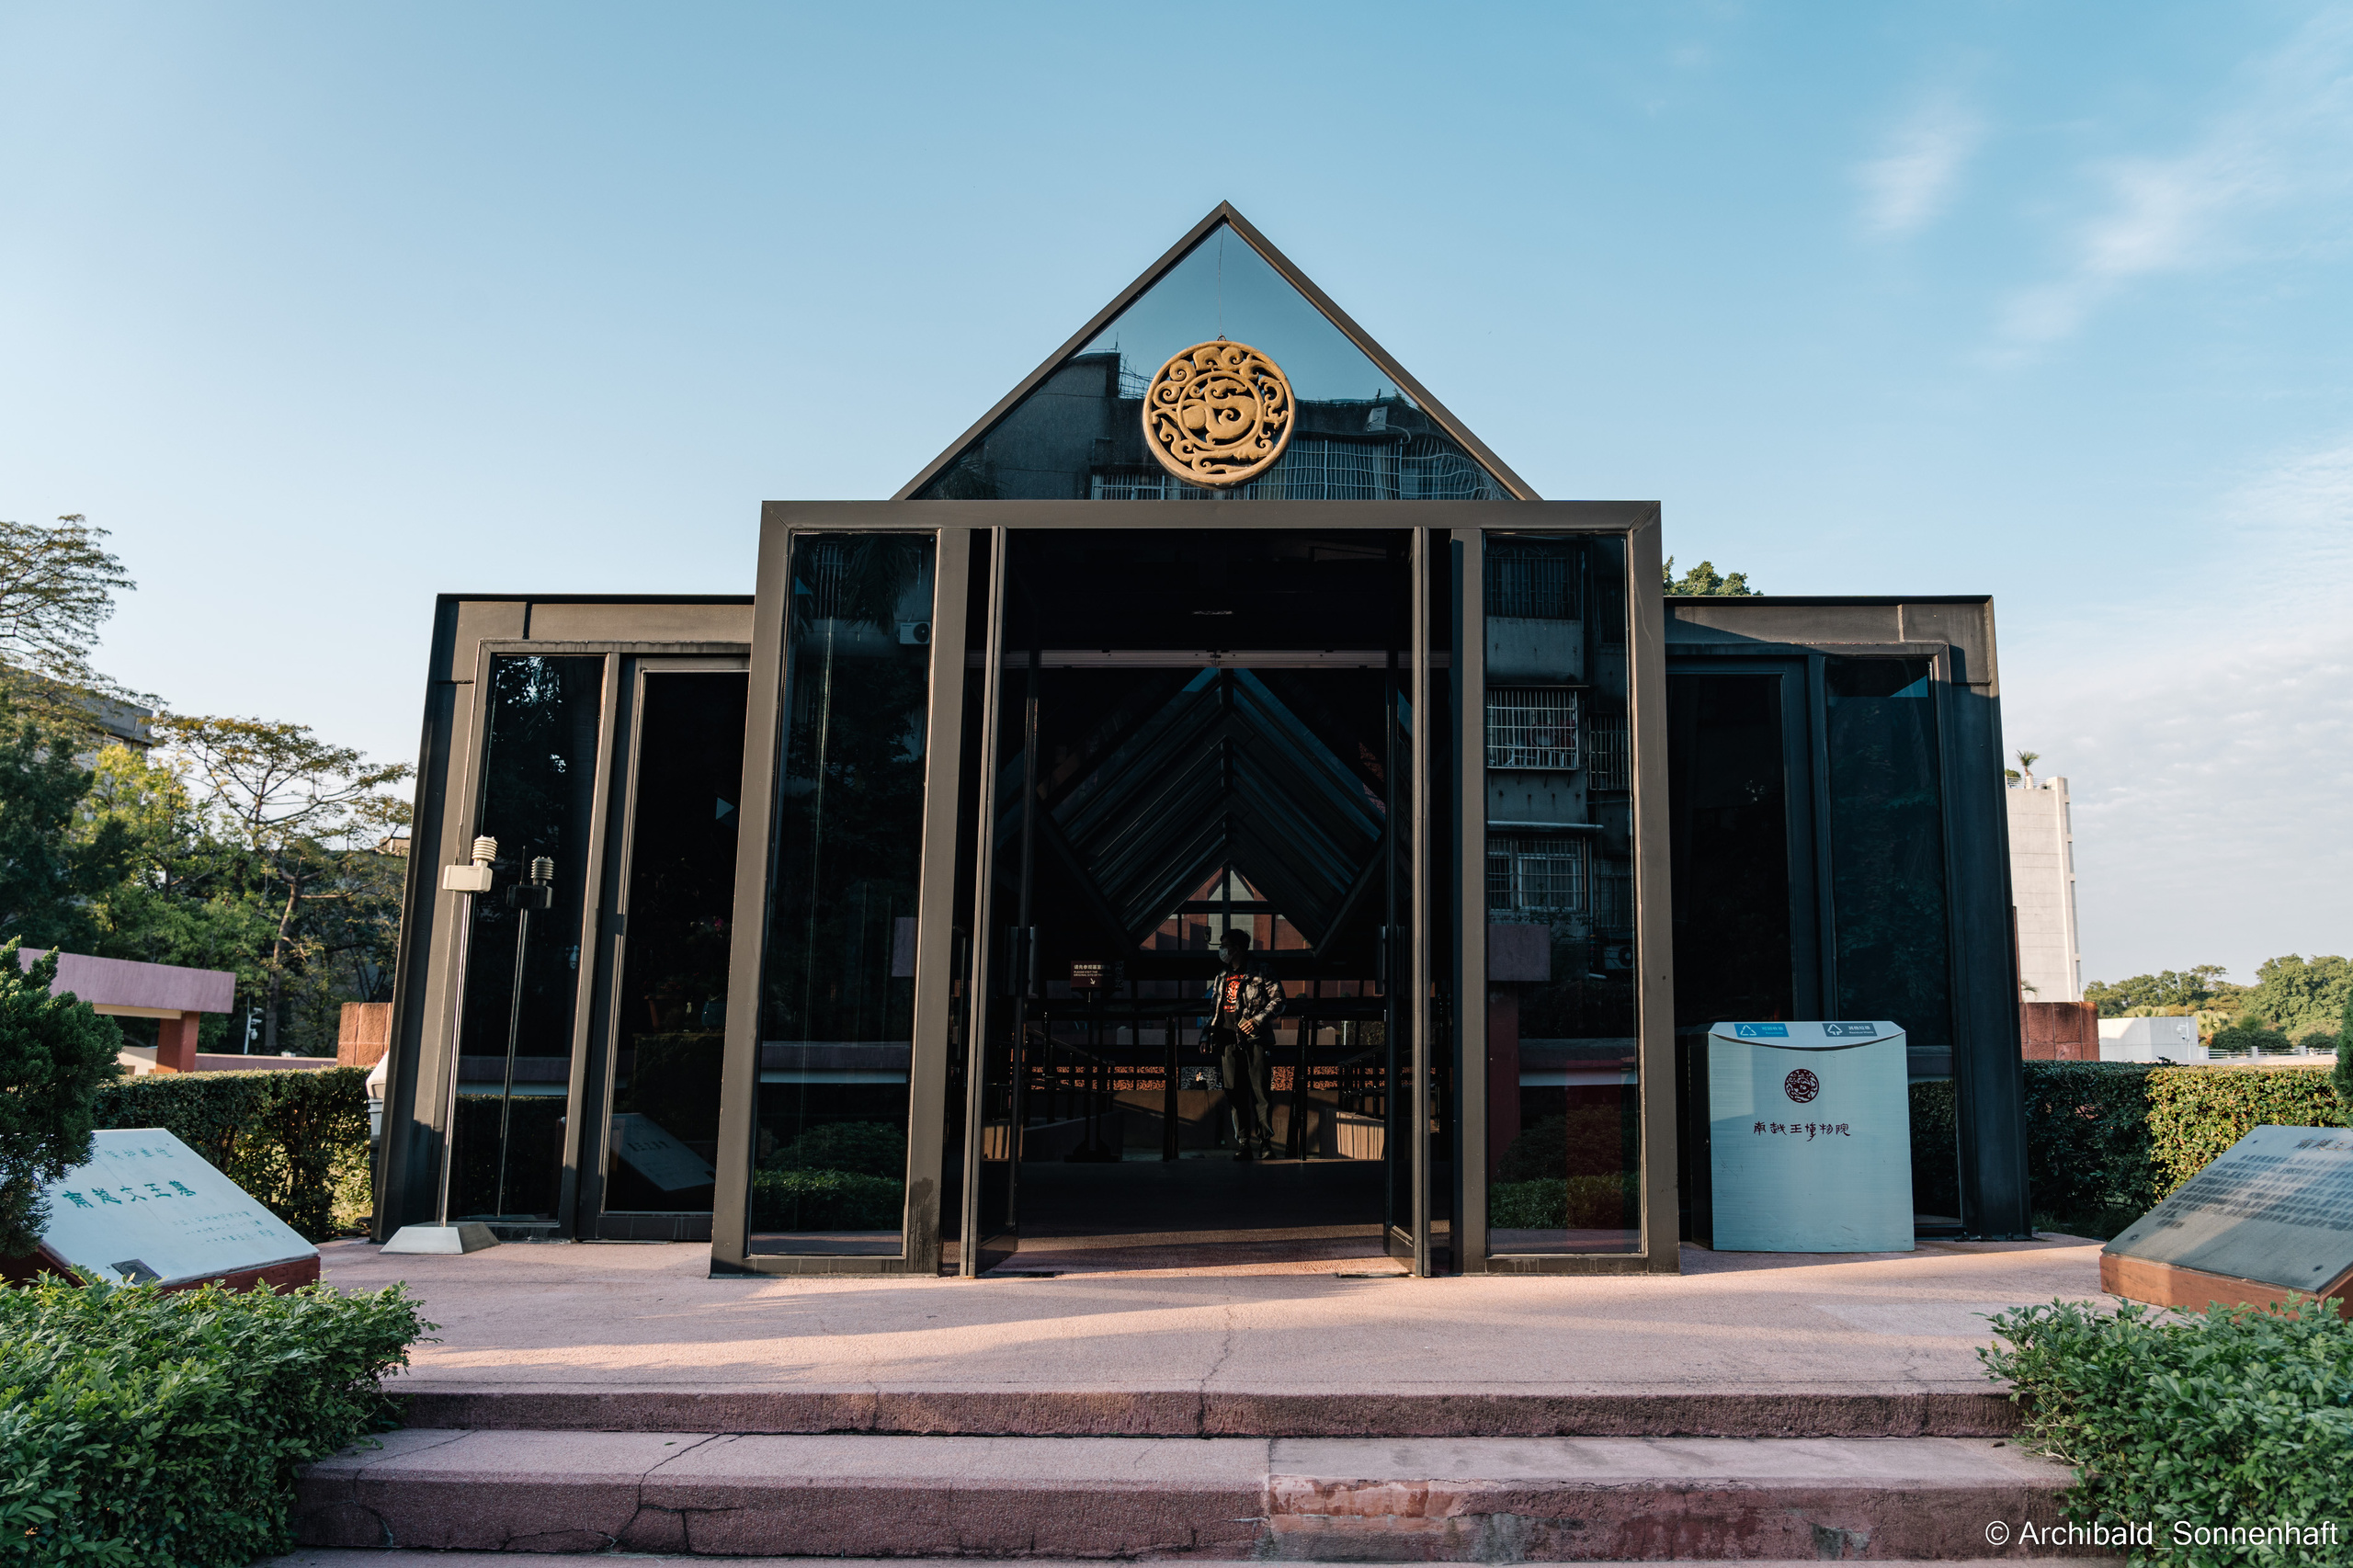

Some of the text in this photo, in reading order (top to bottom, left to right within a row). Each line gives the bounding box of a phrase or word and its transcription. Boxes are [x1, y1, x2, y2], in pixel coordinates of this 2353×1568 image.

[1753, 1120, 1851, 1142] 南越王博物院
